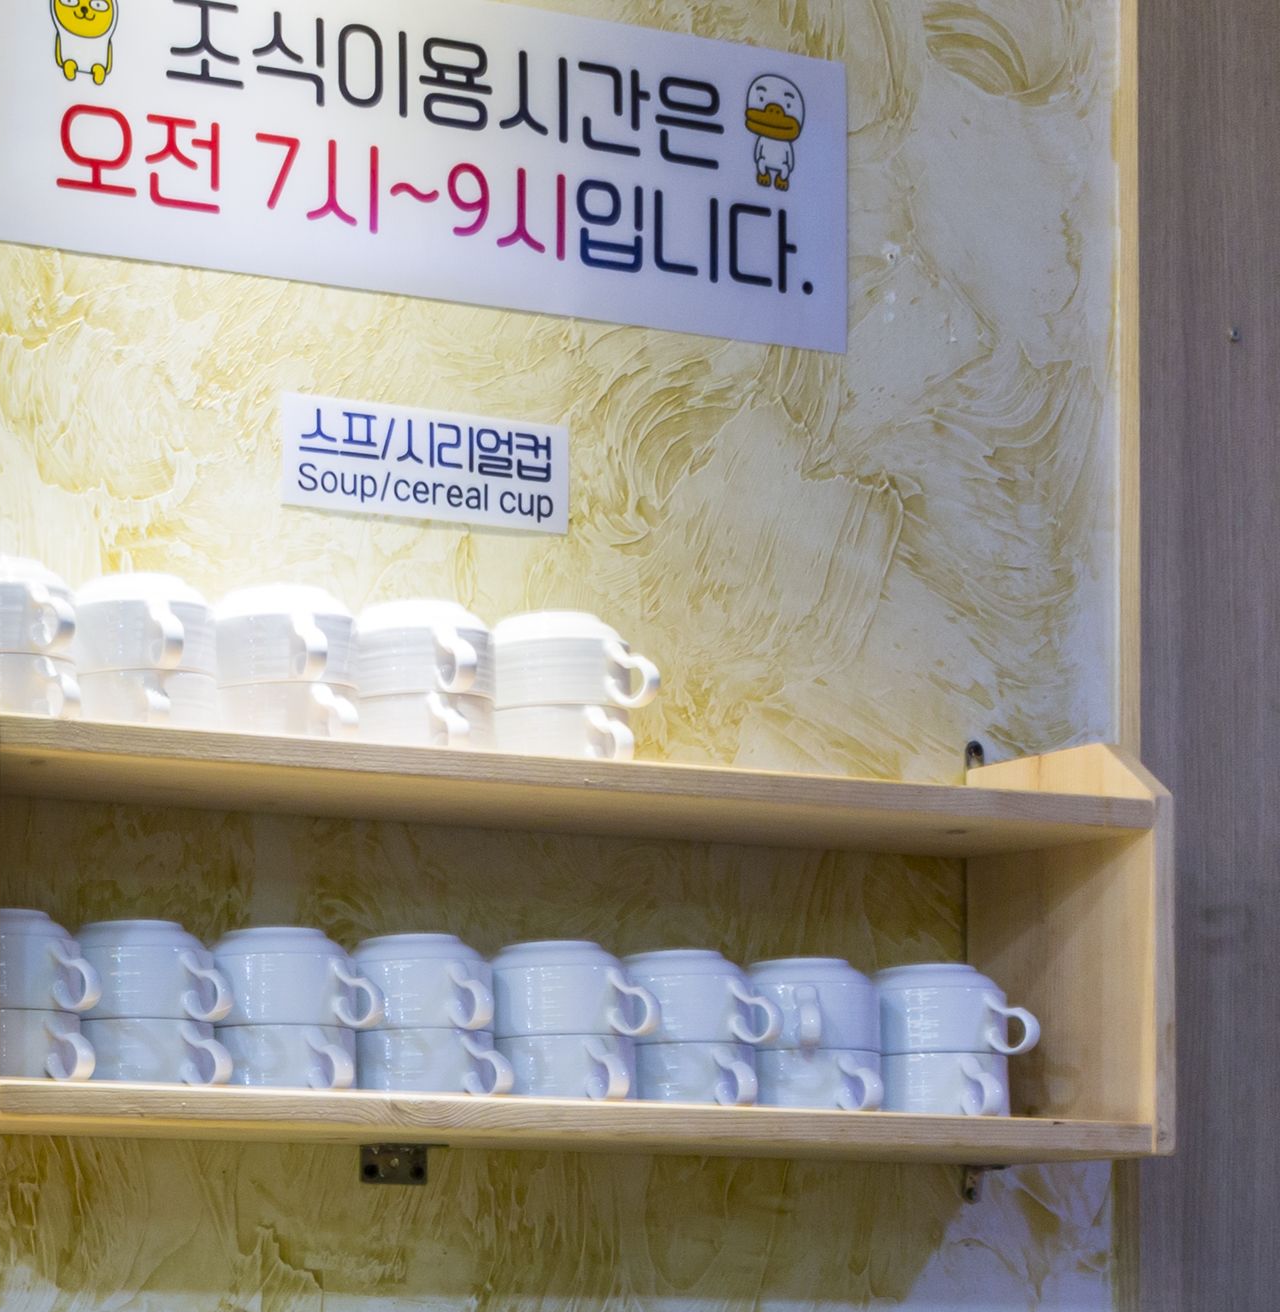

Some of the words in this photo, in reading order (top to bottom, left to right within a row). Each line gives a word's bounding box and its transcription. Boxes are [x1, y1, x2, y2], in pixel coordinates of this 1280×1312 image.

[166, 0, 724, 170] 조식이용시간은
[56, 104, 222, 215] 오전
[255, 131, 816, 297] 7시~9시입니다.
[297, 460, 490, 514] Soup/cereal
[498, 487, 555, 524] cup
[298, 406, 553, 483] 스프/시리얼컵
